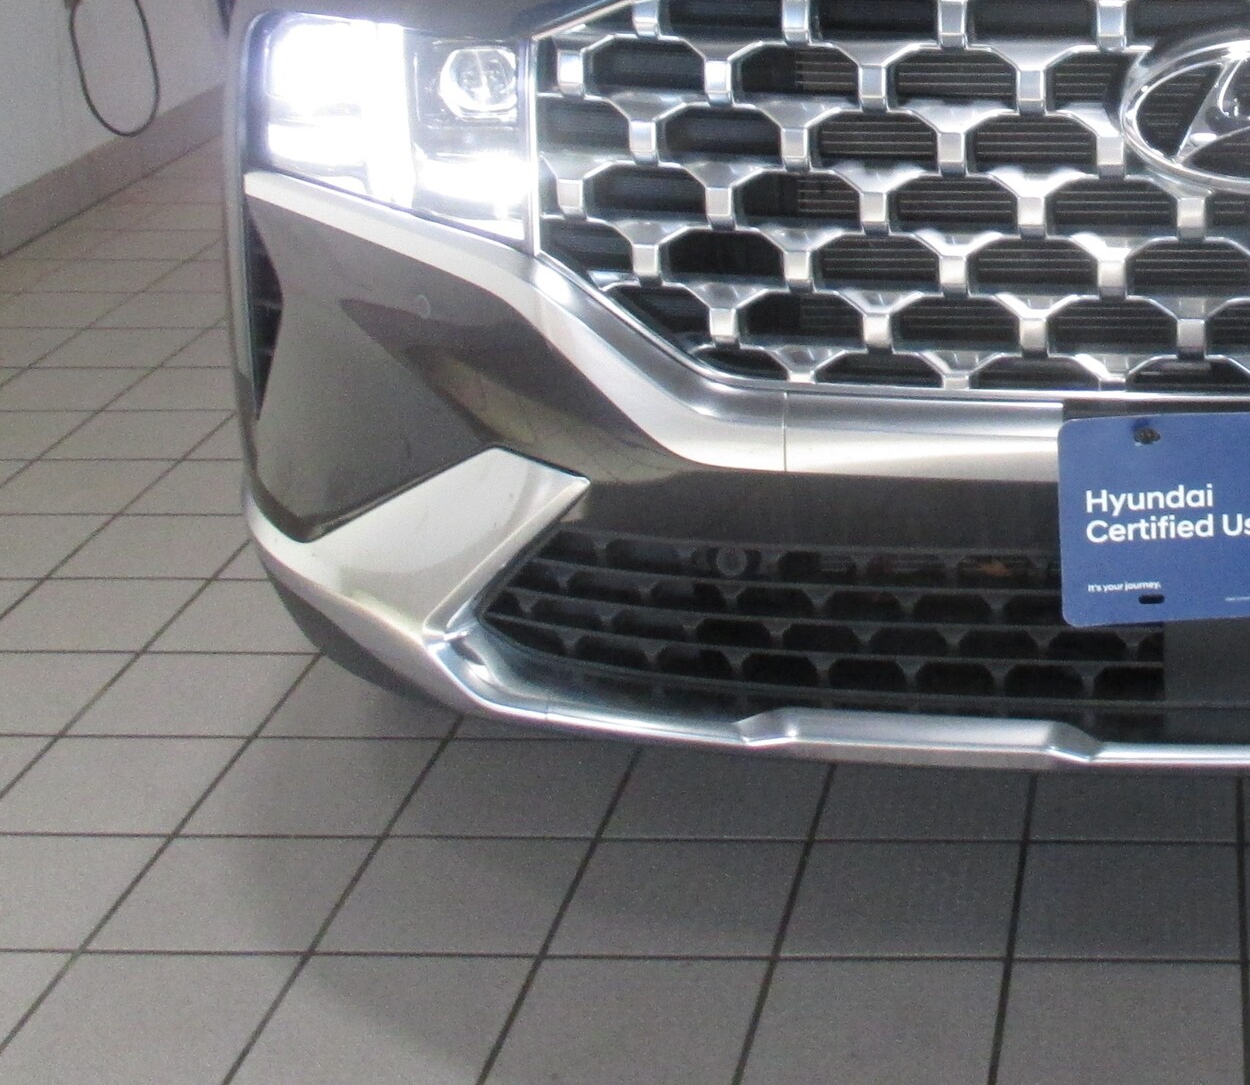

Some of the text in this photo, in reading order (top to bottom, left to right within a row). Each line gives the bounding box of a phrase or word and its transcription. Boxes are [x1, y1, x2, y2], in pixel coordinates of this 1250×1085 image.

[1085, 483, 1214, 517] Hyundai
[1085, 514, 1214, 544] Certified
[1103, 583, 1124, 594] your
